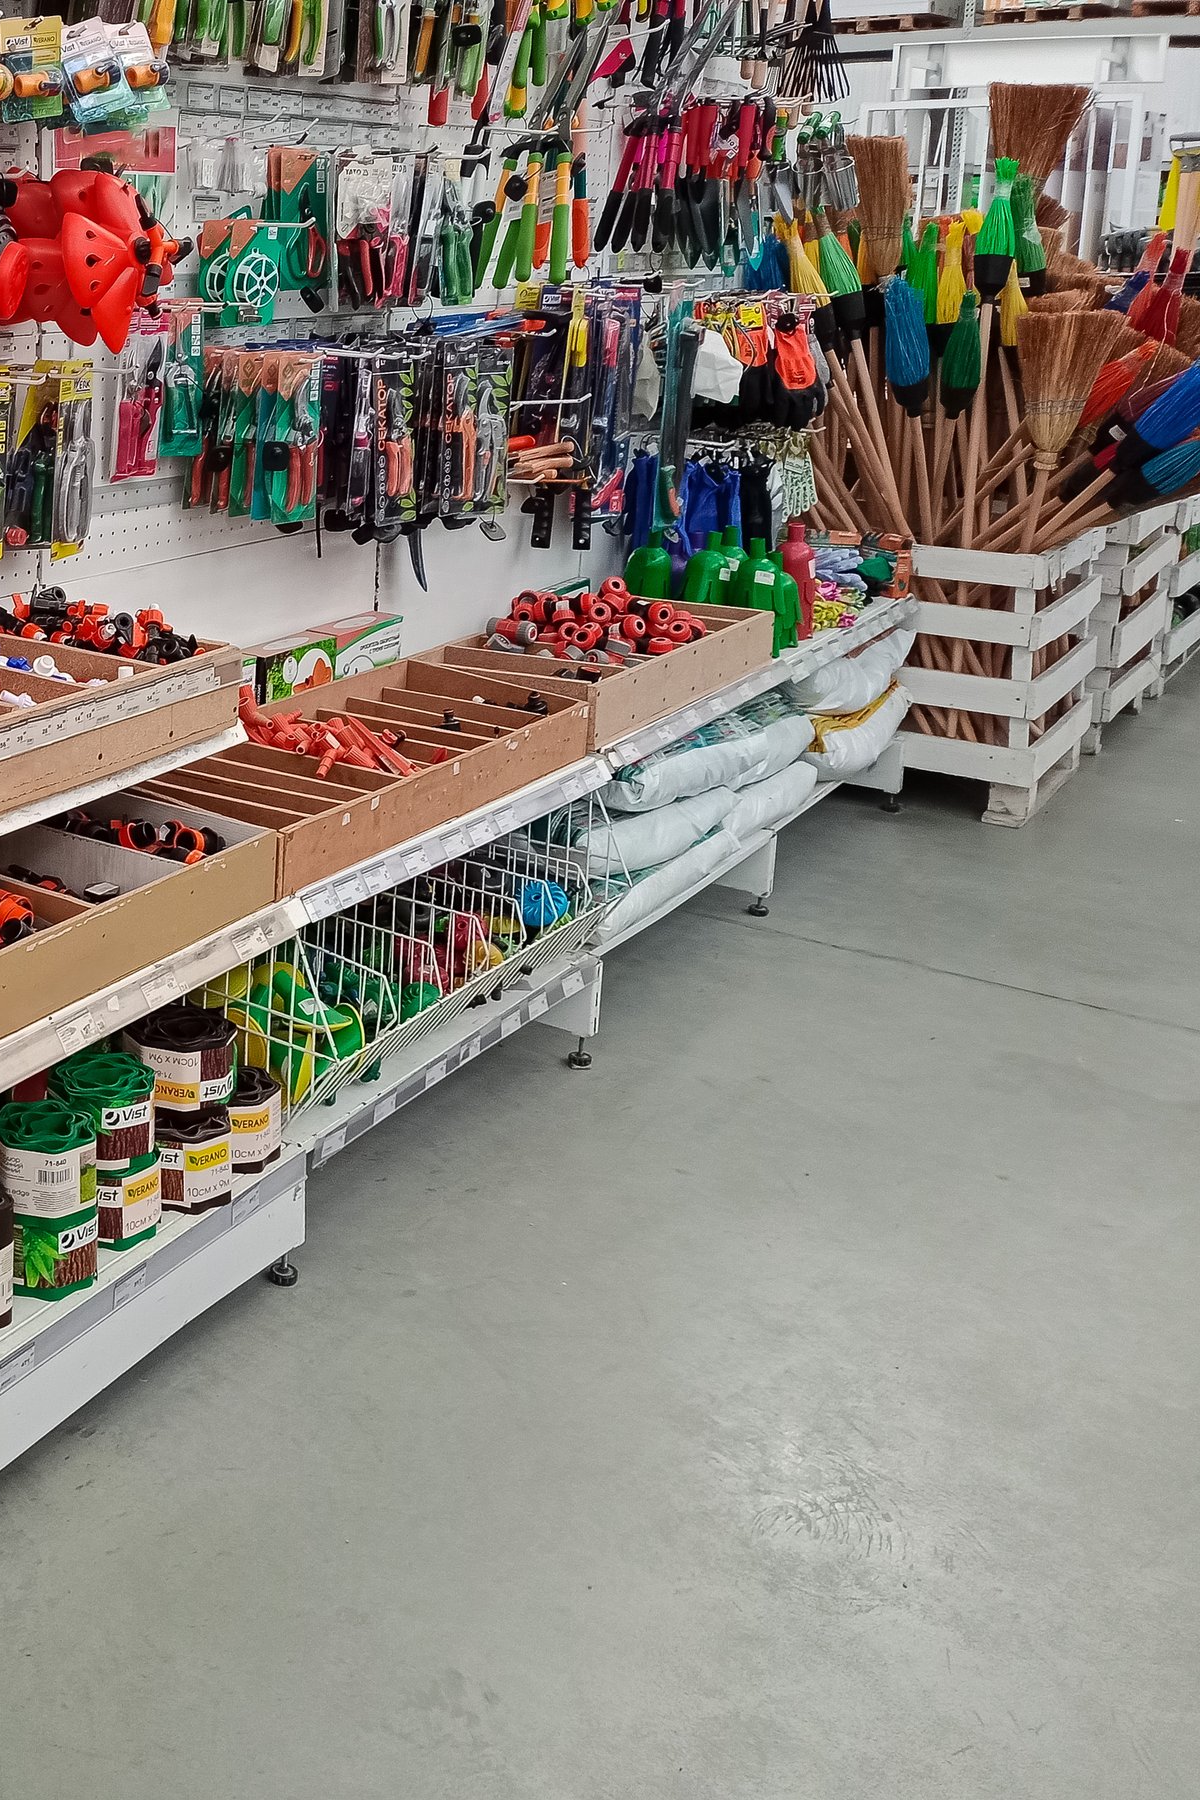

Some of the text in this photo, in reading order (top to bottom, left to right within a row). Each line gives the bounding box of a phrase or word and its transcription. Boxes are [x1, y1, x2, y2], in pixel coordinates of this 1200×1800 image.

[14, 38, 29, 46] Vist
[377, 378, 387, 451] СЕКАТОР
[445, 373, 454, 444] СЕКАТОР
[203, 1083, 227, 1097] Vist
[122, 1107, 148, 1121] Vist
[236, 1115, 269, 1129] VERANO
[45, 1159, 66, 1167] 71-840
[161, 1148, 227, 1167] ist VERANO
[77, 1221, 97, 1240] Vist
